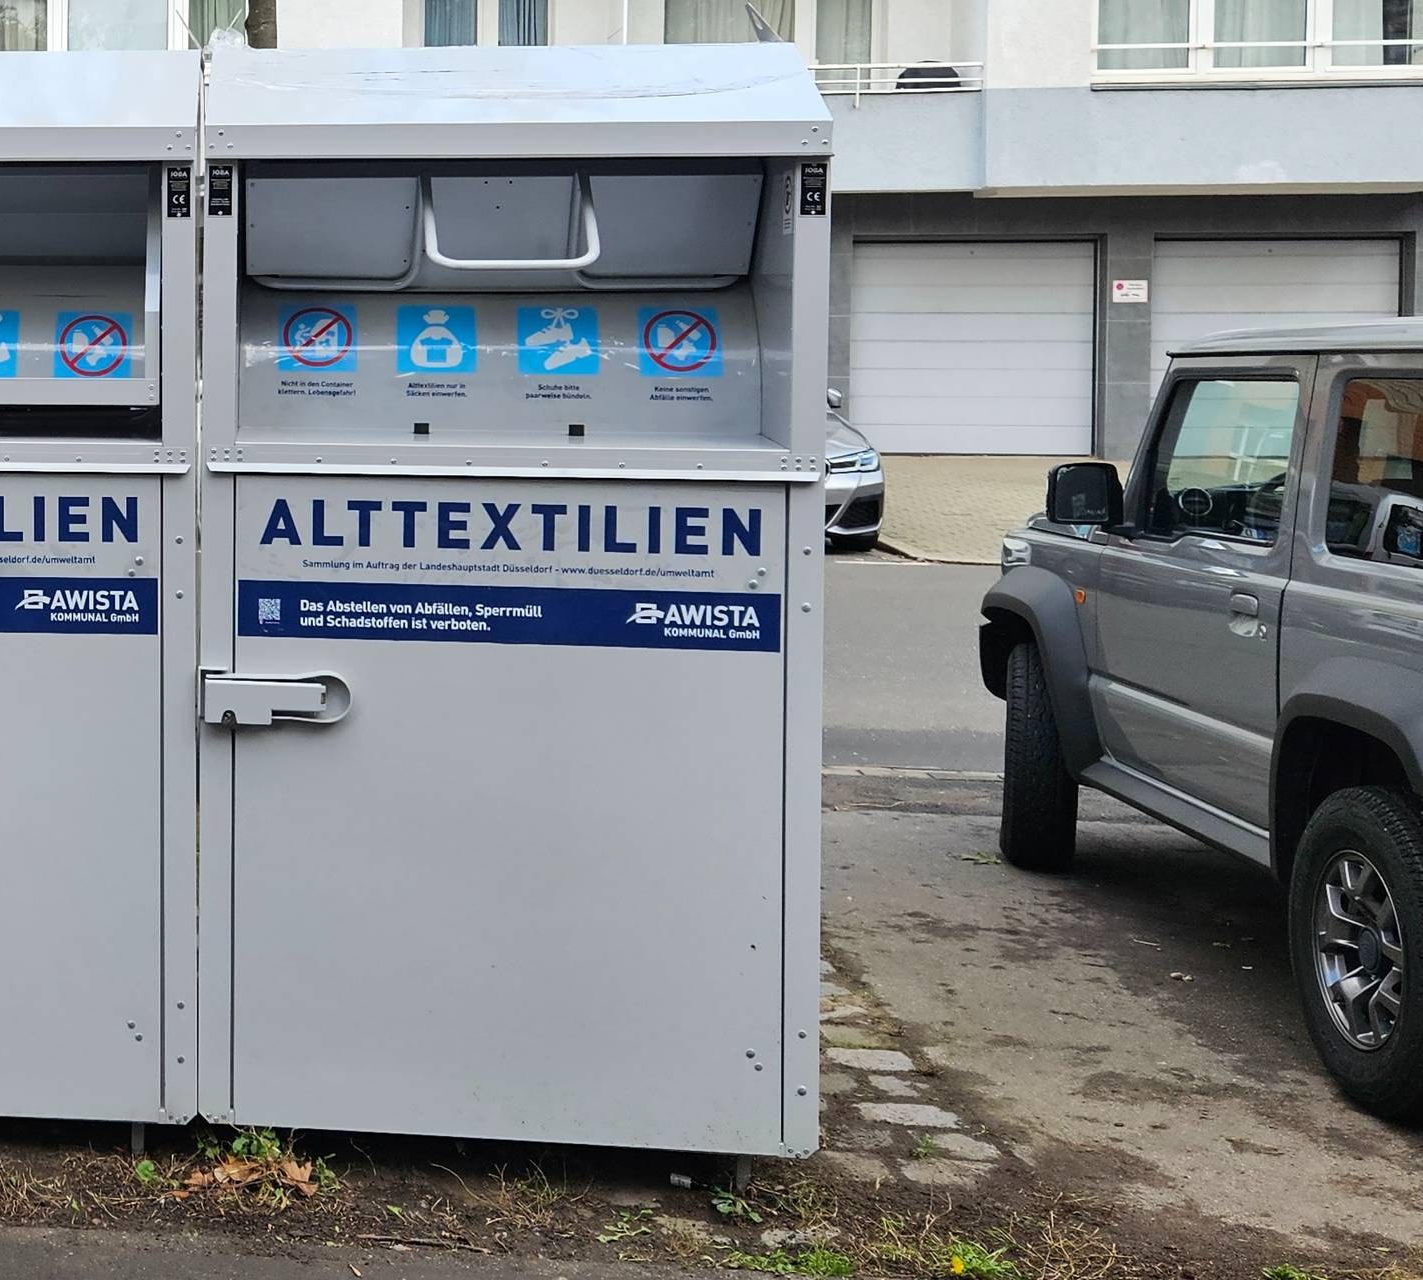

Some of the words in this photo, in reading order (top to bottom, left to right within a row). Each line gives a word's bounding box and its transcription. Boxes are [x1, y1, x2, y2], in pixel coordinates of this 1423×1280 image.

[280, 380, 298, 388] Nicht
[308, 380, 320, 388] den
[321, 380, 353, 389] Container
[538, 383, 562, 391] Schuhe
[260, 499, 762, 557] ALTTEXTILIEN
[303, 559, 350, 570] Sammlung
[353, 561, 364, 569] im
[366, 561, 400, 571] Auftrag
[402, 562, 417, 570] der
[420, 562, 500, 573] Landeshauptstadt
[503, 564, 553, 574] Düsseldorf
[561, 567, 714, 578] www.duesseldorf.de/umweltamt
[51, 590, 139, 610] AWISTA
[50, 613, 108, 622] KOMMUNAL
[111, 614, 139, 622] GmbH
[300, 600, 324, 612] Das
[327, 601, 386, 614] Abstellen
[390, 605, 412, 614] von
[416, 603, 472, 618] Abfällen,
[476, 604, 542, 618] Sperrmüll
[664, 604, 760, 627] AWISTA
[300, 615, 324, 627] und
[327, 615, 408, 629] Schadstoffen
[411, 617, 428, 629] ist
[431, 617, 490, 631] verboten.
[664, 628, 726, 638] KOMMUNAL
[729, 629, 760, 639] GmbH
